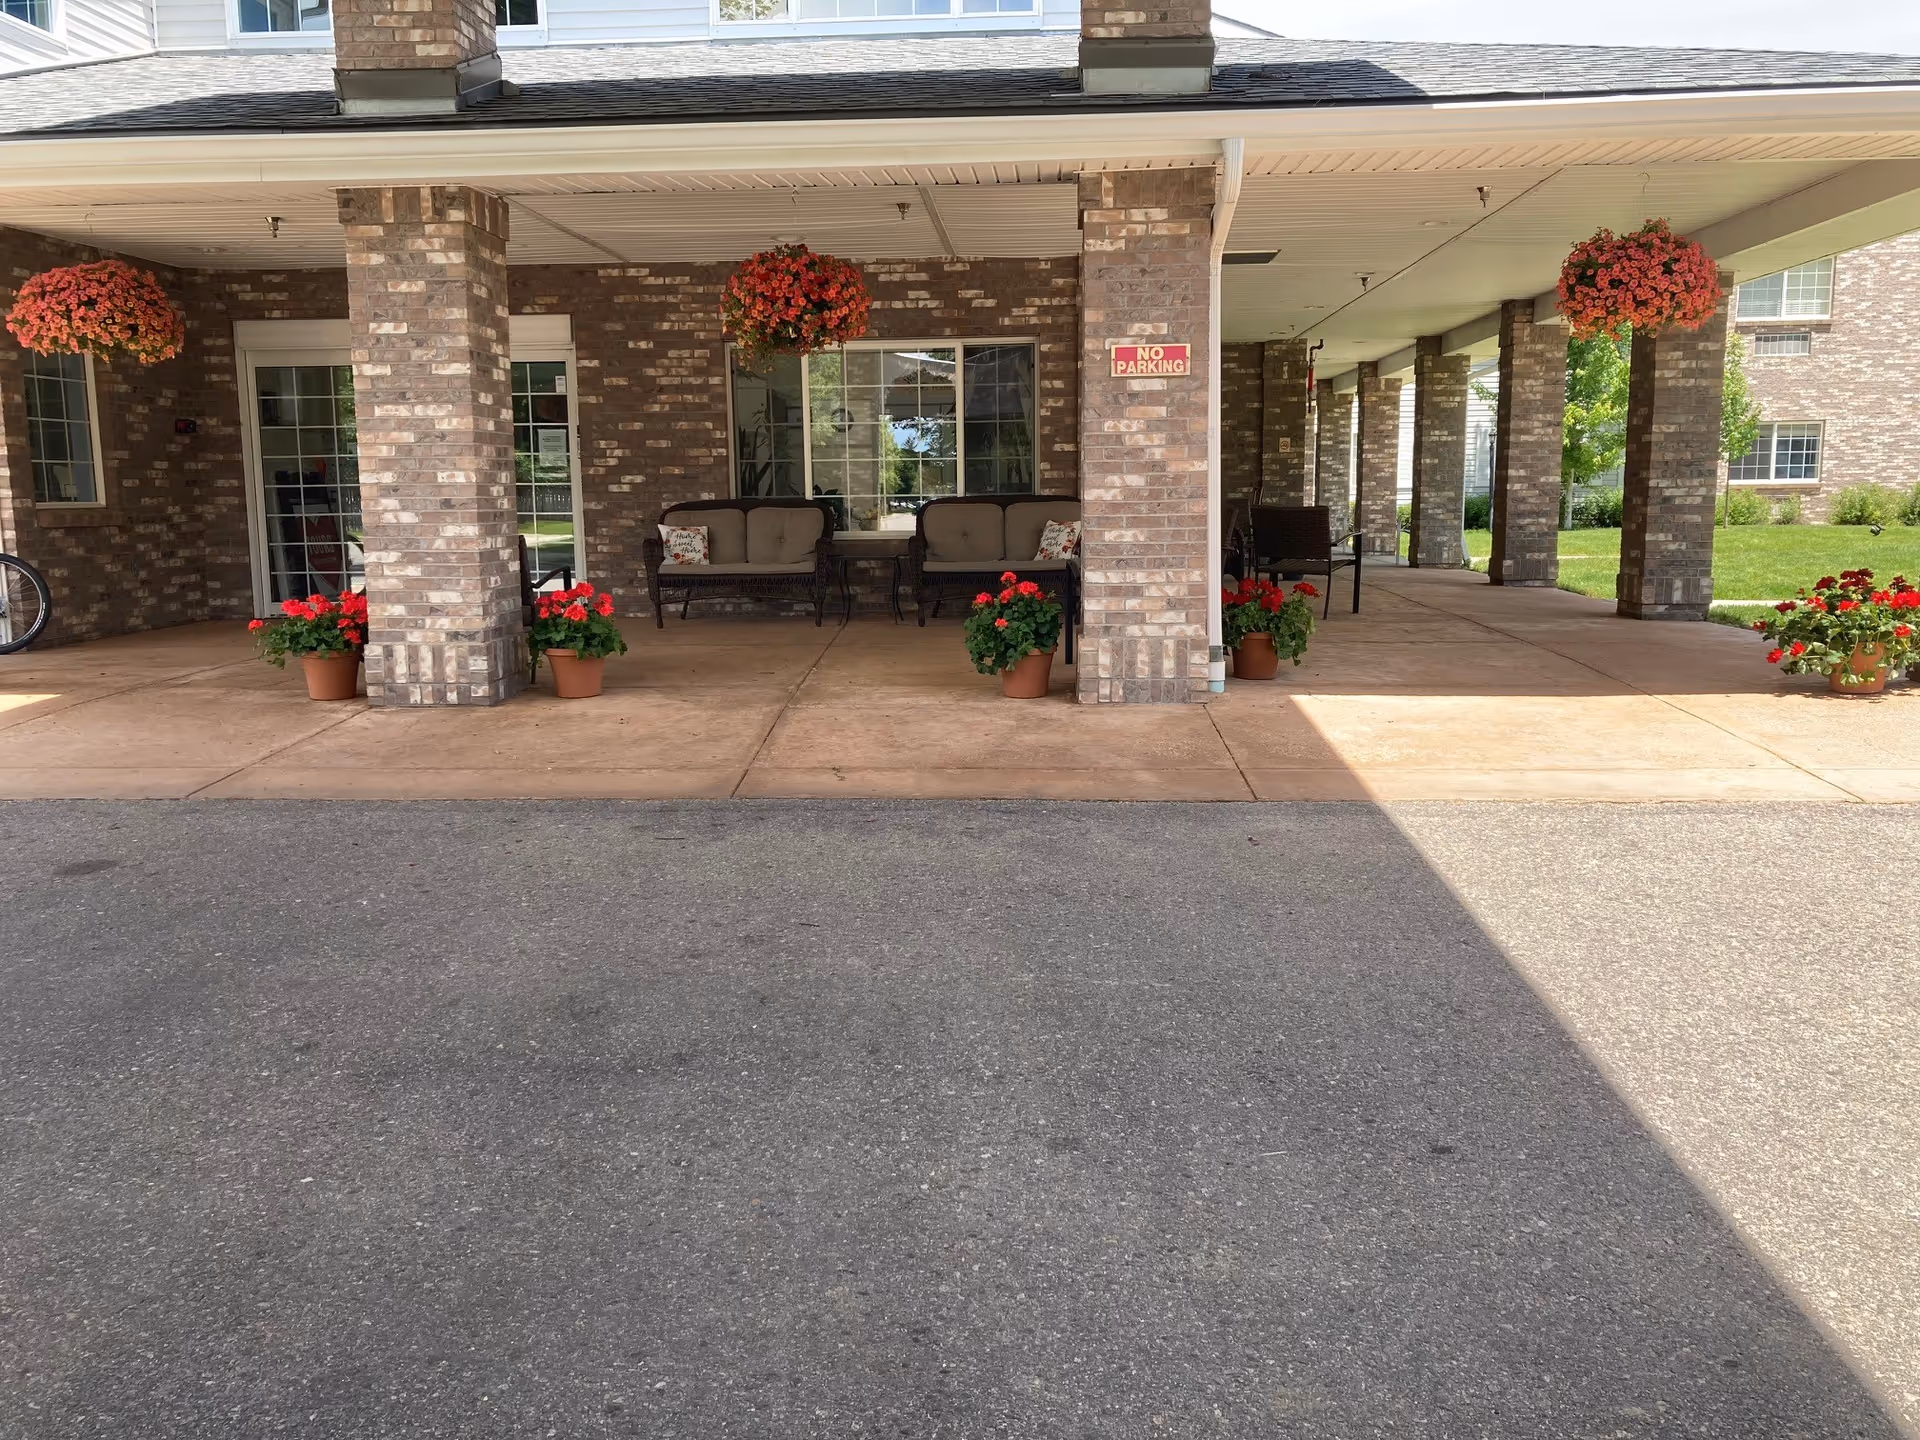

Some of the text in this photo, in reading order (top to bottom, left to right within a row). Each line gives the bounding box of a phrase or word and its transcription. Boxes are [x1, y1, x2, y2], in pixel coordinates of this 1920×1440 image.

[1137, 347, 1164, 360] NO
[1117, 359, 1184, 374] PARKING
[674, 532, 697, 540] Home
[673, 540, 695, 548] Sweet
[680, 547, 702, 555] Home
